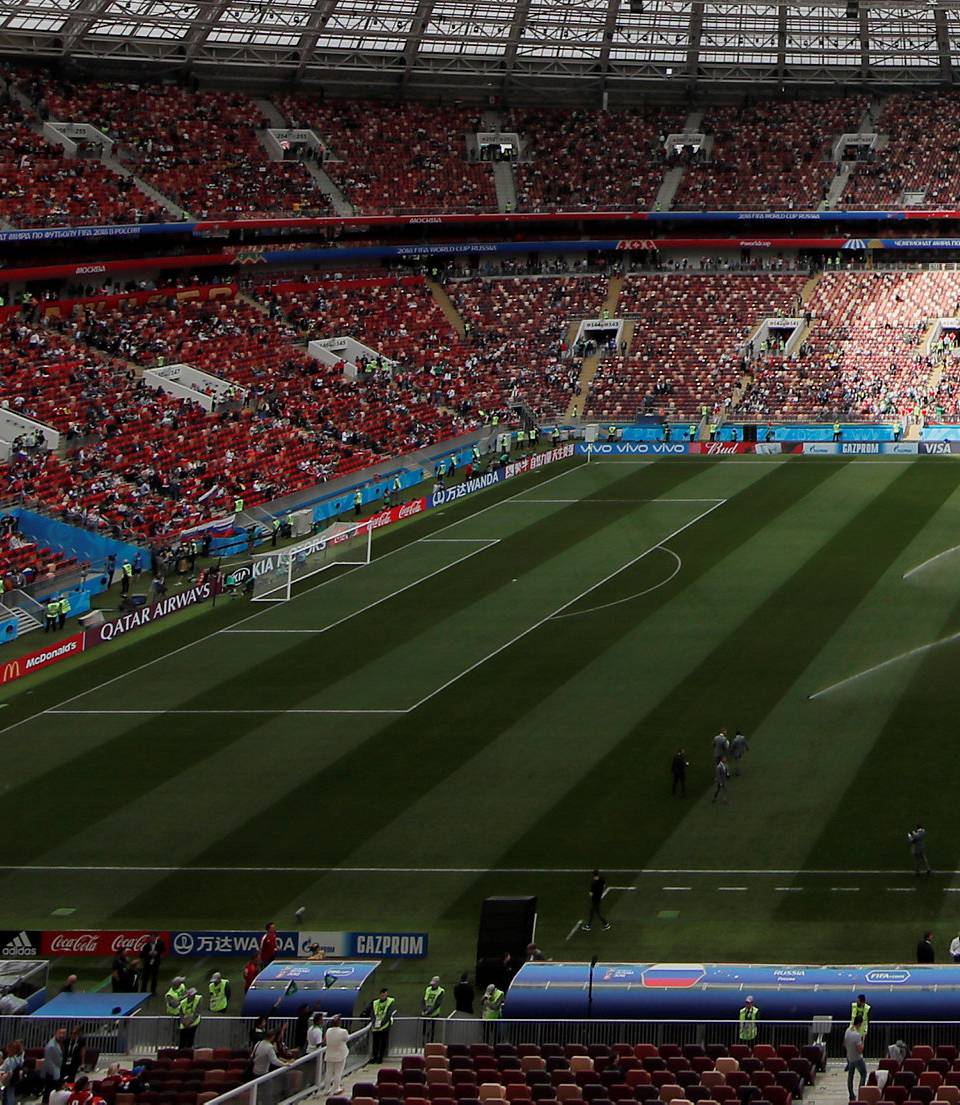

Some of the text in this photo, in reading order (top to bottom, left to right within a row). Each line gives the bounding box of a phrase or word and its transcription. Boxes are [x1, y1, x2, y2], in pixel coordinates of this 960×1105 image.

[617, 443, 648, 453] vivo
[653, 443, 685, 453] vivo
[705, 441, 740, 456] Bud
[842, 443, 879, 453] GAZPROM
[925, 443, 952, 454] VISA
[466, 471, 499, 492] WANDA
[253, 560, 275, 578] KIA
[100, 581, 211, 641] QATAR AIRWAYS
[26, 641, 77, 669] McDonald's
[2, 946, 36, 956] adidas
[51, 934, 99, 952] Coca-Cola
[197, 936, 296, 952] 万达 WADA
[357, 936, 423, 954] GAZPROM
